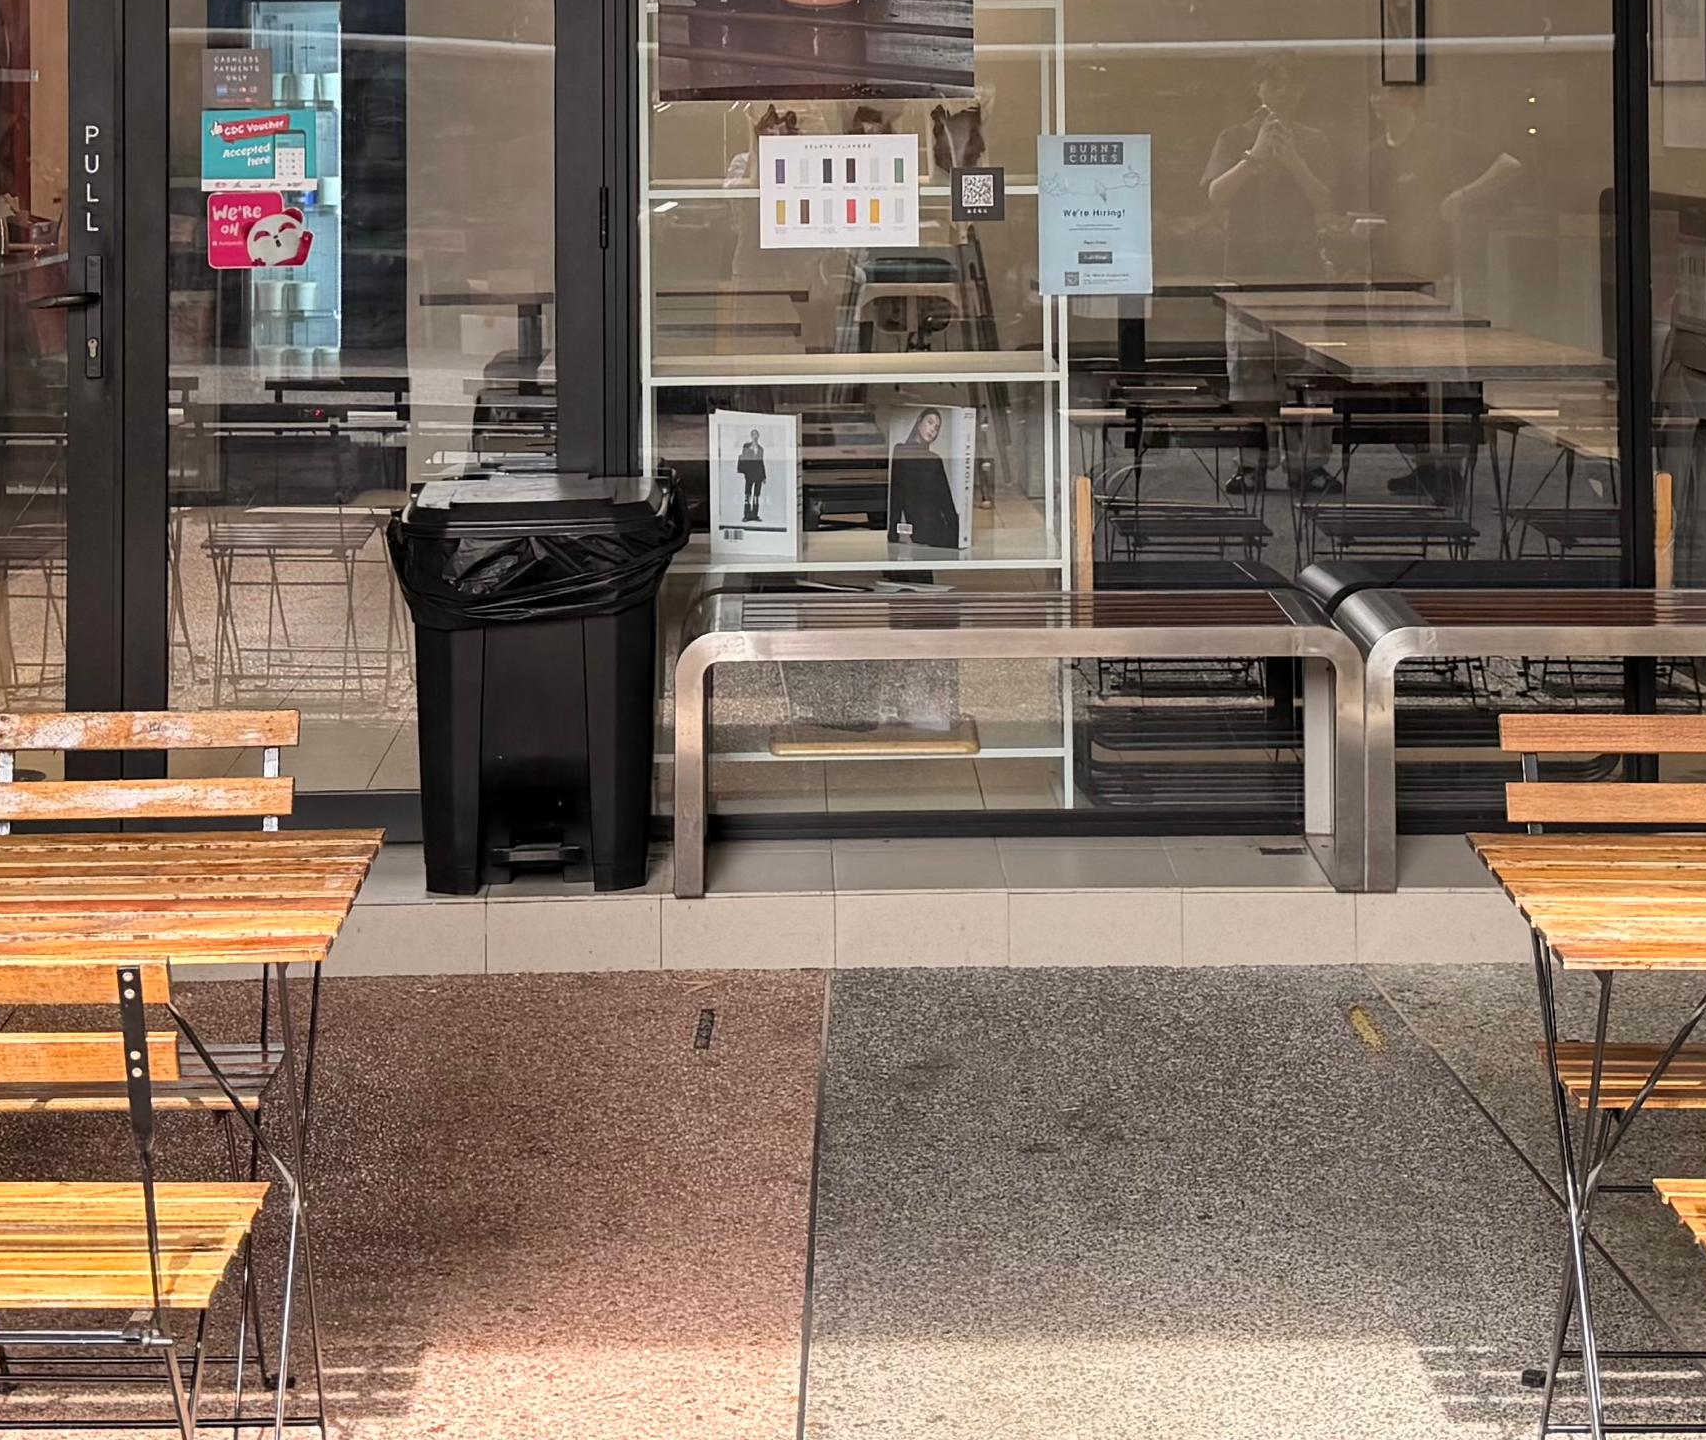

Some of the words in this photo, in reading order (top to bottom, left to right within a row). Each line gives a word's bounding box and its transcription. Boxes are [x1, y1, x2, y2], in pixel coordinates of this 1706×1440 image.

[213, 55, 260, 63] CASHLESS
[213, 64, 260, 73] PAYMENTS
[224, 125, 245, 136] CDC
[246, 120, 285, 133] Voucher
[222, 143, 271, 159] Accepted
[1068, 144, 1119, 153] BURNT
[247, 155, 271, 167] here
[1068, 154, 1119, 163] CONES
[84, 125, 99, 232] PULL
[1062, 208, 1089, 217] We're
[1093, 208, 1126, 219] Hiring!
